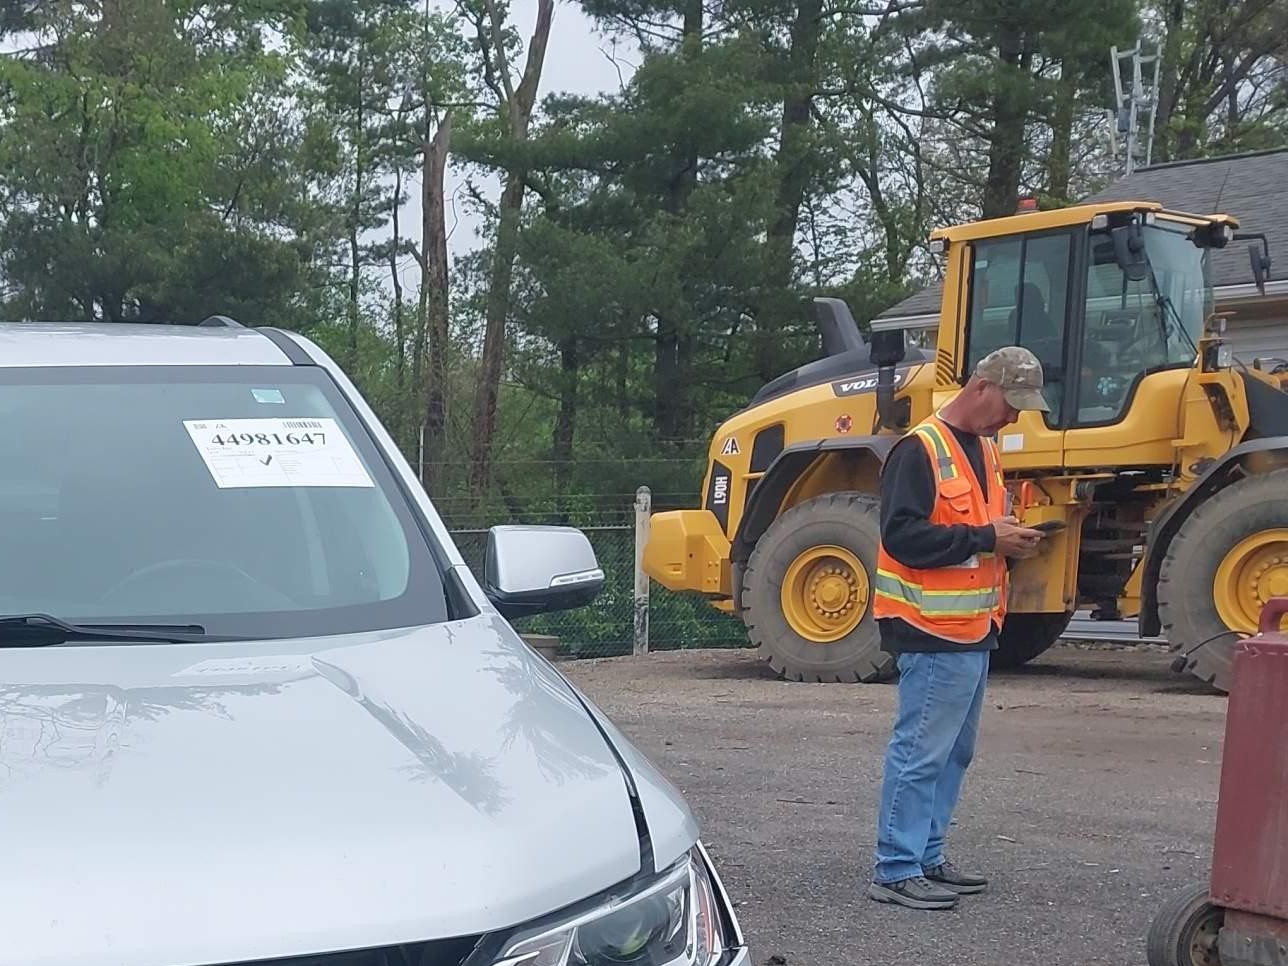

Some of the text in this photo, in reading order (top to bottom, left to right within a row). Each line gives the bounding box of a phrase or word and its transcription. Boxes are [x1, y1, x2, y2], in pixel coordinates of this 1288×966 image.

[840, 374, 902, 392] VOLO
[211, 432, 325, 446] 44981647
[713, 476, 729, 504] L90H
